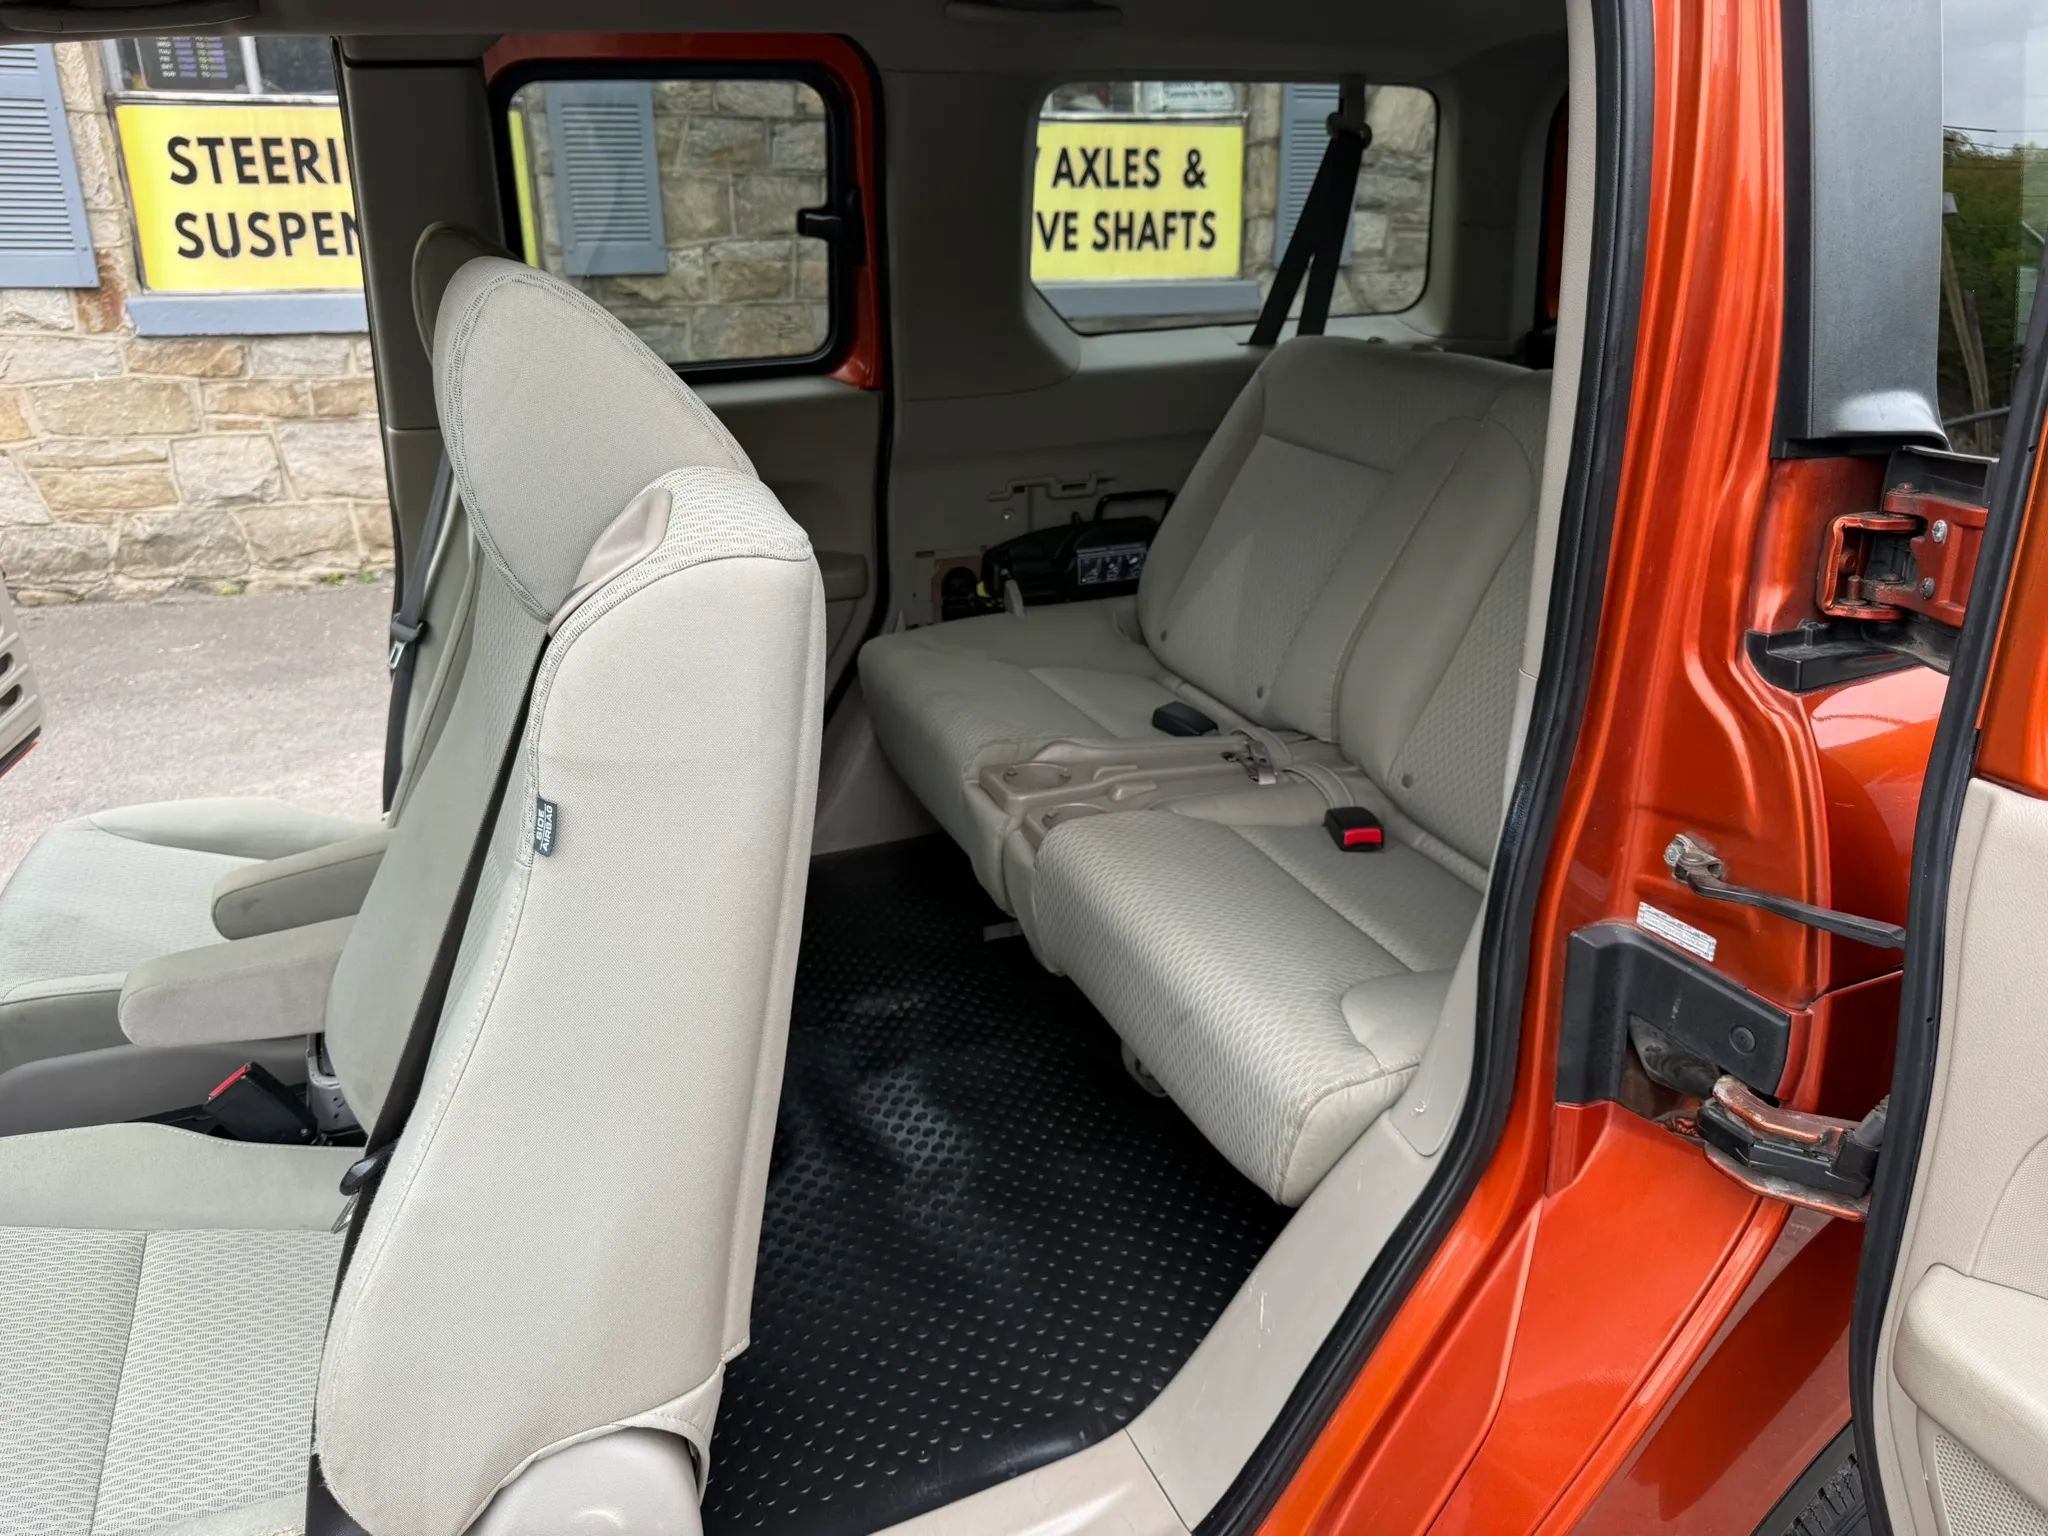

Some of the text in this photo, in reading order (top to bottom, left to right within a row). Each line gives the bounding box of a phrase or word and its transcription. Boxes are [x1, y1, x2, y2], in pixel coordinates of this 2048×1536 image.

[167, 136, 342, 185] STEERI
[1052, 147, 1161, 189] AXLES
[1183, 148, 1206, 189] &
[1036, 210, 1216, 252] VE SHAFTS
[536, 808, 545, 841] SIDE
[542, 804, 553, 852] AIRBAG
